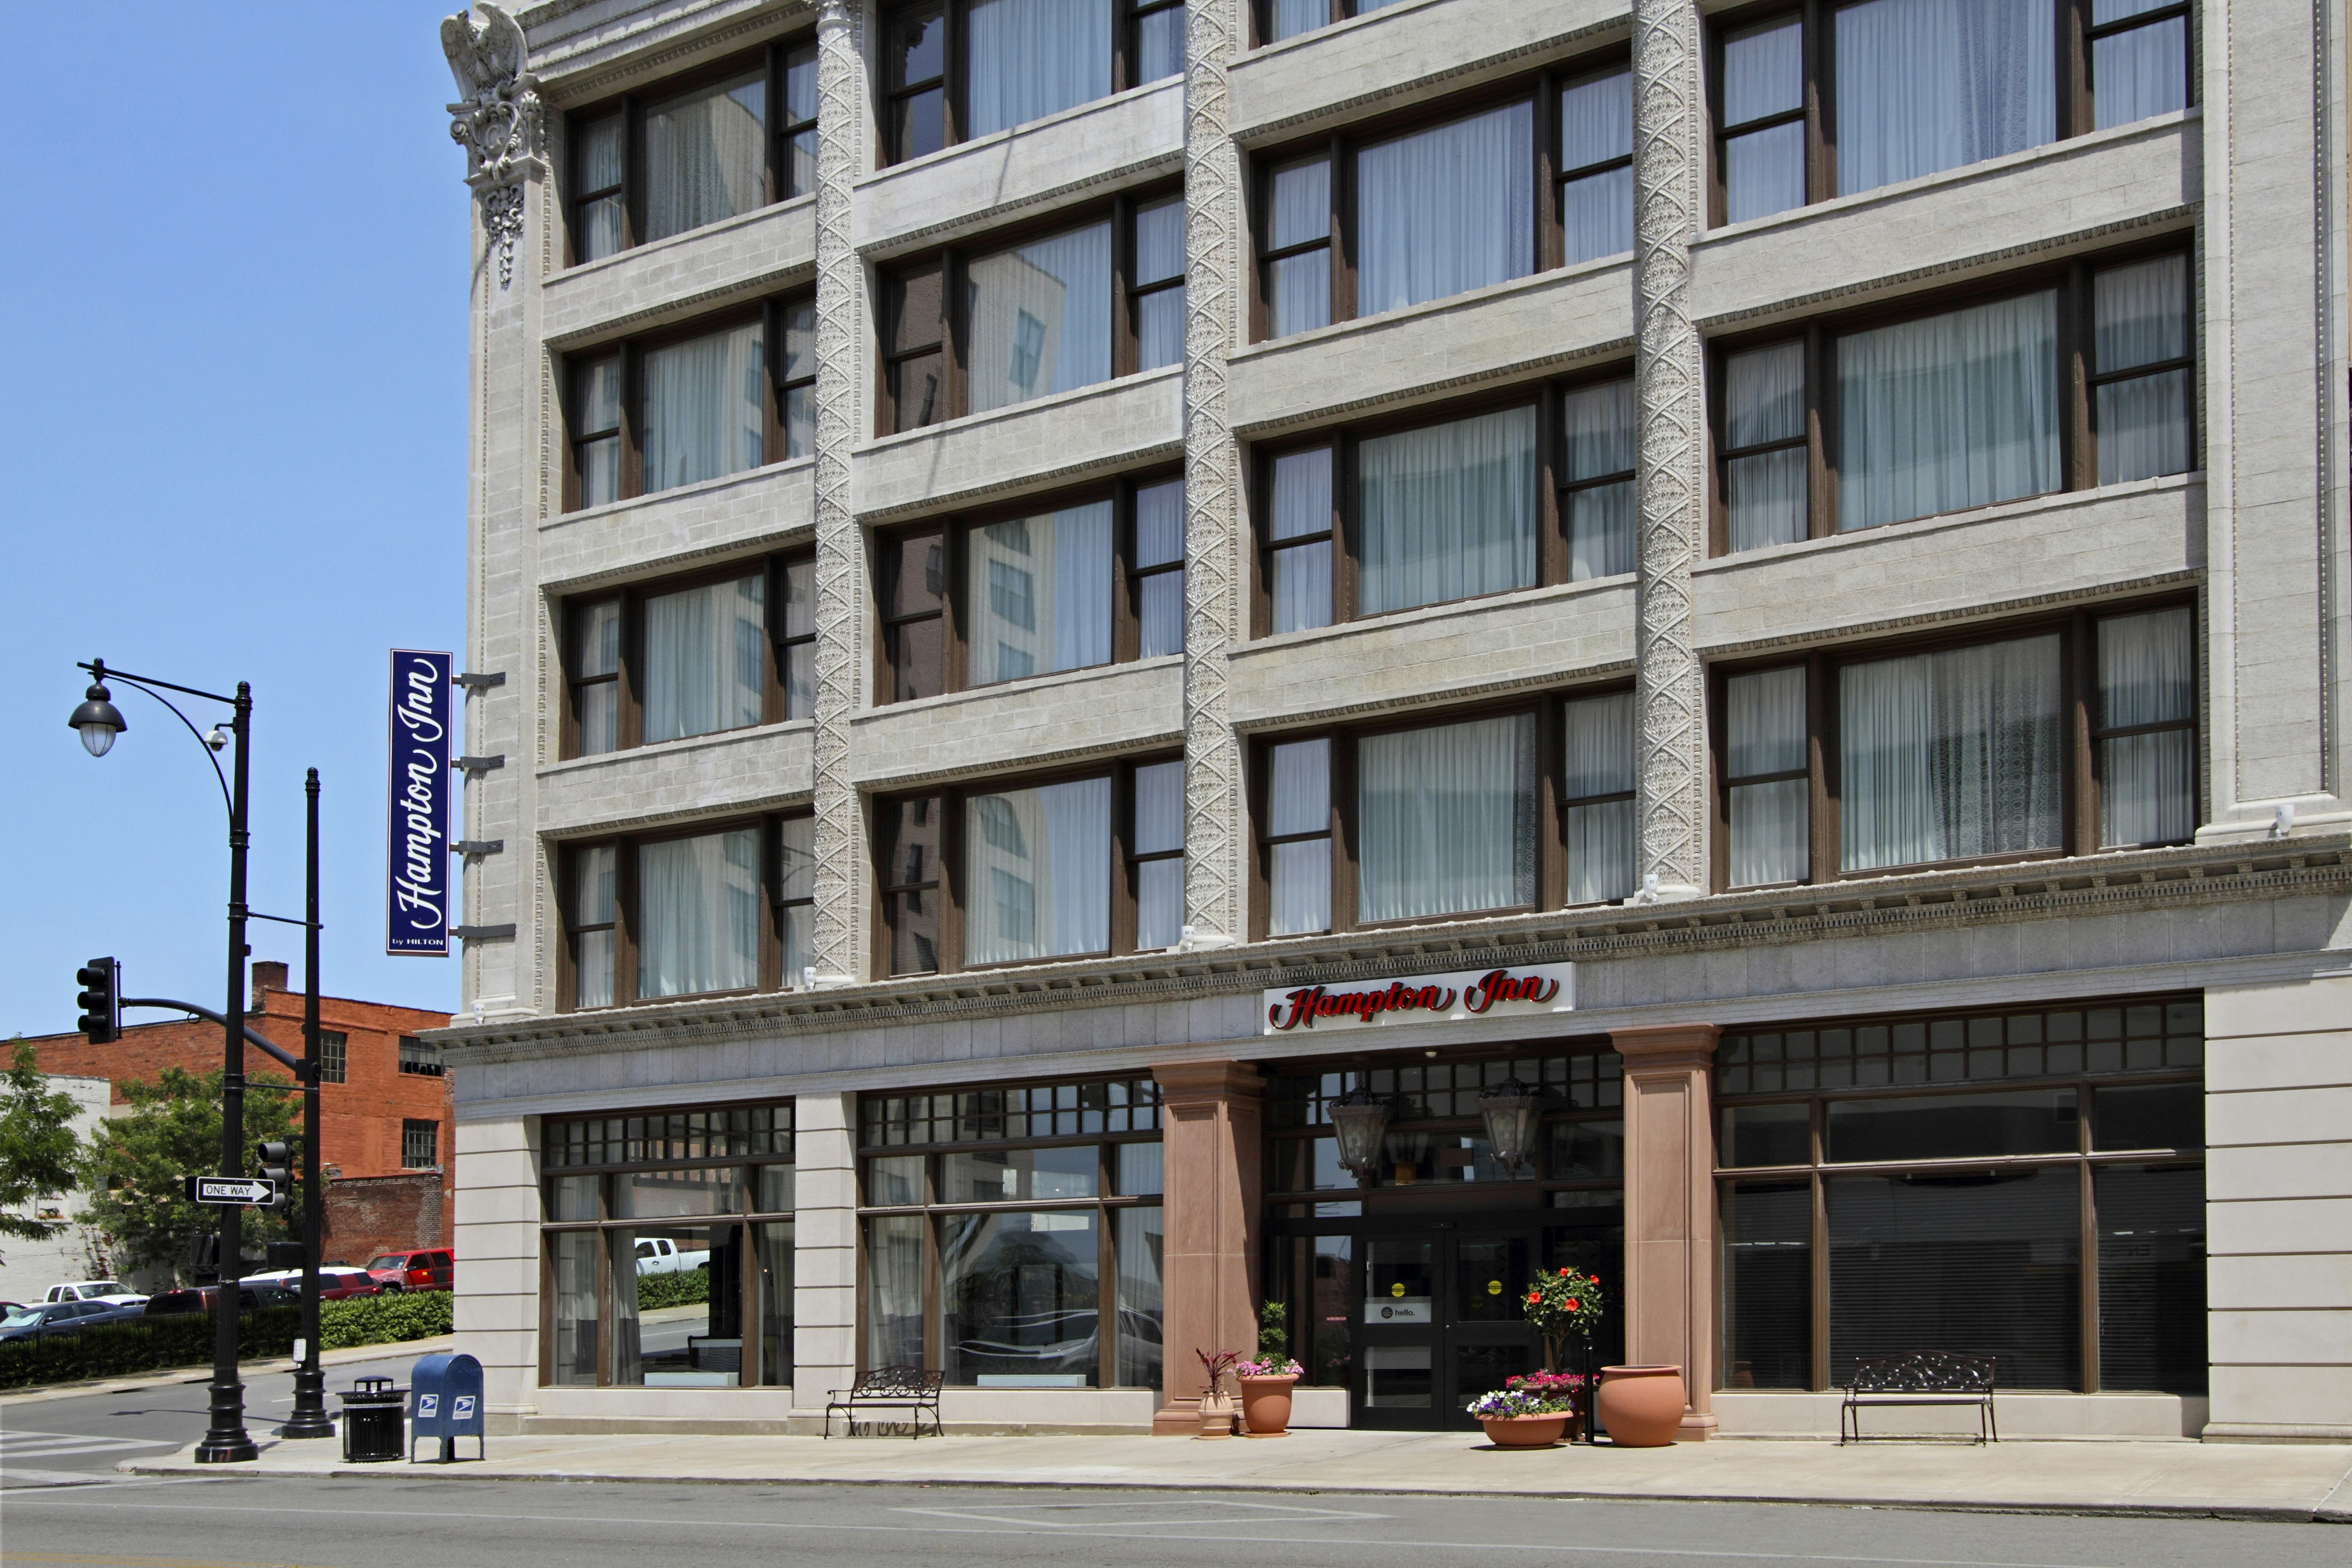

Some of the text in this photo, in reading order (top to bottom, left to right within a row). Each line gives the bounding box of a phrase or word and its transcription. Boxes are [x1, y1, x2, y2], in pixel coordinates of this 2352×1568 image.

[395, 658, 443, 929] Hampton Inn
[1269, 969, 1559, 1029] Hampton Inn
[206, 1185, 251, 1196] ONE WAY
